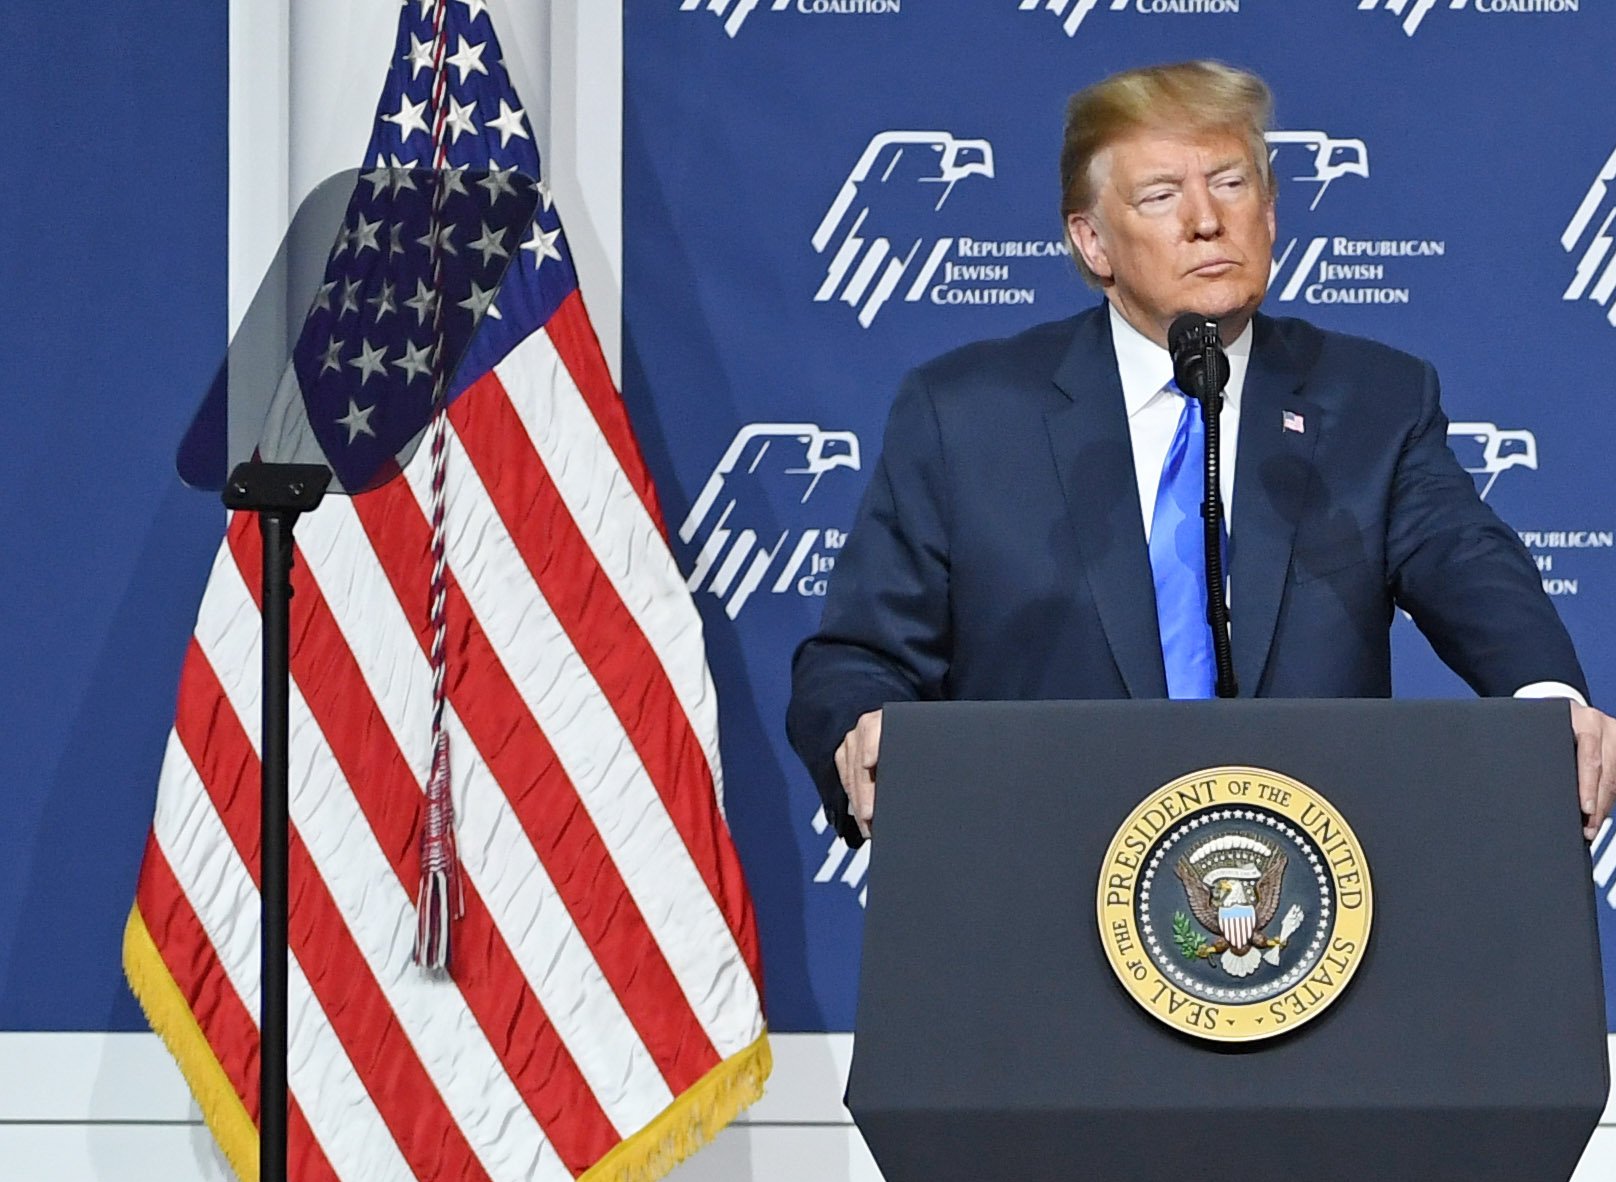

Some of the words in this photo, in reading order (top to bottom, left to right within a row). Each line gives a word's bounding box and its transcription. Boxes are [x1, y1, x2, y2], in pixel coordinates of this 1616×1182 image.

[1333, 237, 1445, 256] REPUBLICAN
[944, 261, 1009, 284] JEWISH
[1318, 260, 1384, 283] JEWISH
[930, 285, 1035, 304] COALITION
[1305, 284, 1409, 304] COALITION
[1518, 530, 1614, 548] PUBLICAN
[1227, 780, 1252, 797] OF
[1257, 783, 1292, 808] THE
[1106, 779, 1218, 907] PRESIDENT
[1300, 802, 1363, 911] UNITED
[1112, 918, 1134, 957] THE
[1125, 958, 1148, 982] OF
[1268, 936, 1356, 1025] STATES
[1149, 978, 1220, 1031] SEAL
